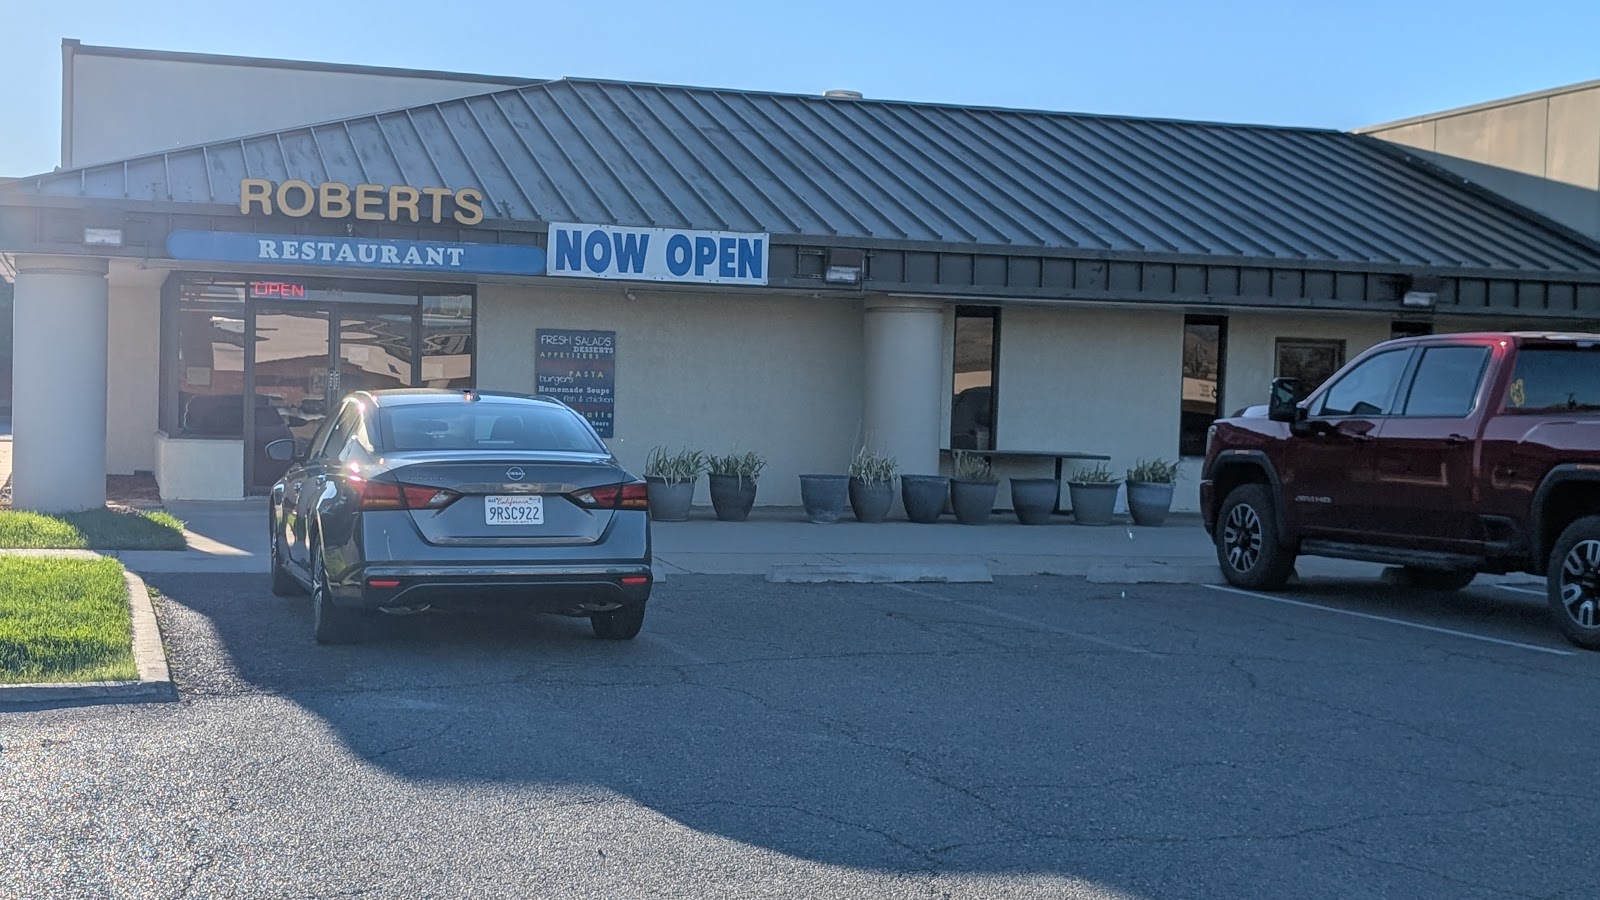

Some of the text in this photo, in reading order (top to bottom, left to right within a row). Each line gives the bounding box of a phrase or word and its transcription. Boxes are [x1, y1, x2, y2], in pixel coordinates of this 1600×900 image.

[240, 178, 483, 225] ROBERTS
[258, 240, 464, 266] RESTAURANT
[555, 229, 763, 278] NOW OPEN
[254, 283, 304, 297] OPEN
[540, 334, 612, 347] FRESH SALADS
[573, 346, 614, 354] DESSERTS
[539, 375, 574, 386] burgers
[568, 370, 604, 378] PASTA
[538, 385, 610, 396] Homemade Soups
[497, 497, 530, 507] California
[489, 506, 540, 521] 9RSC922
